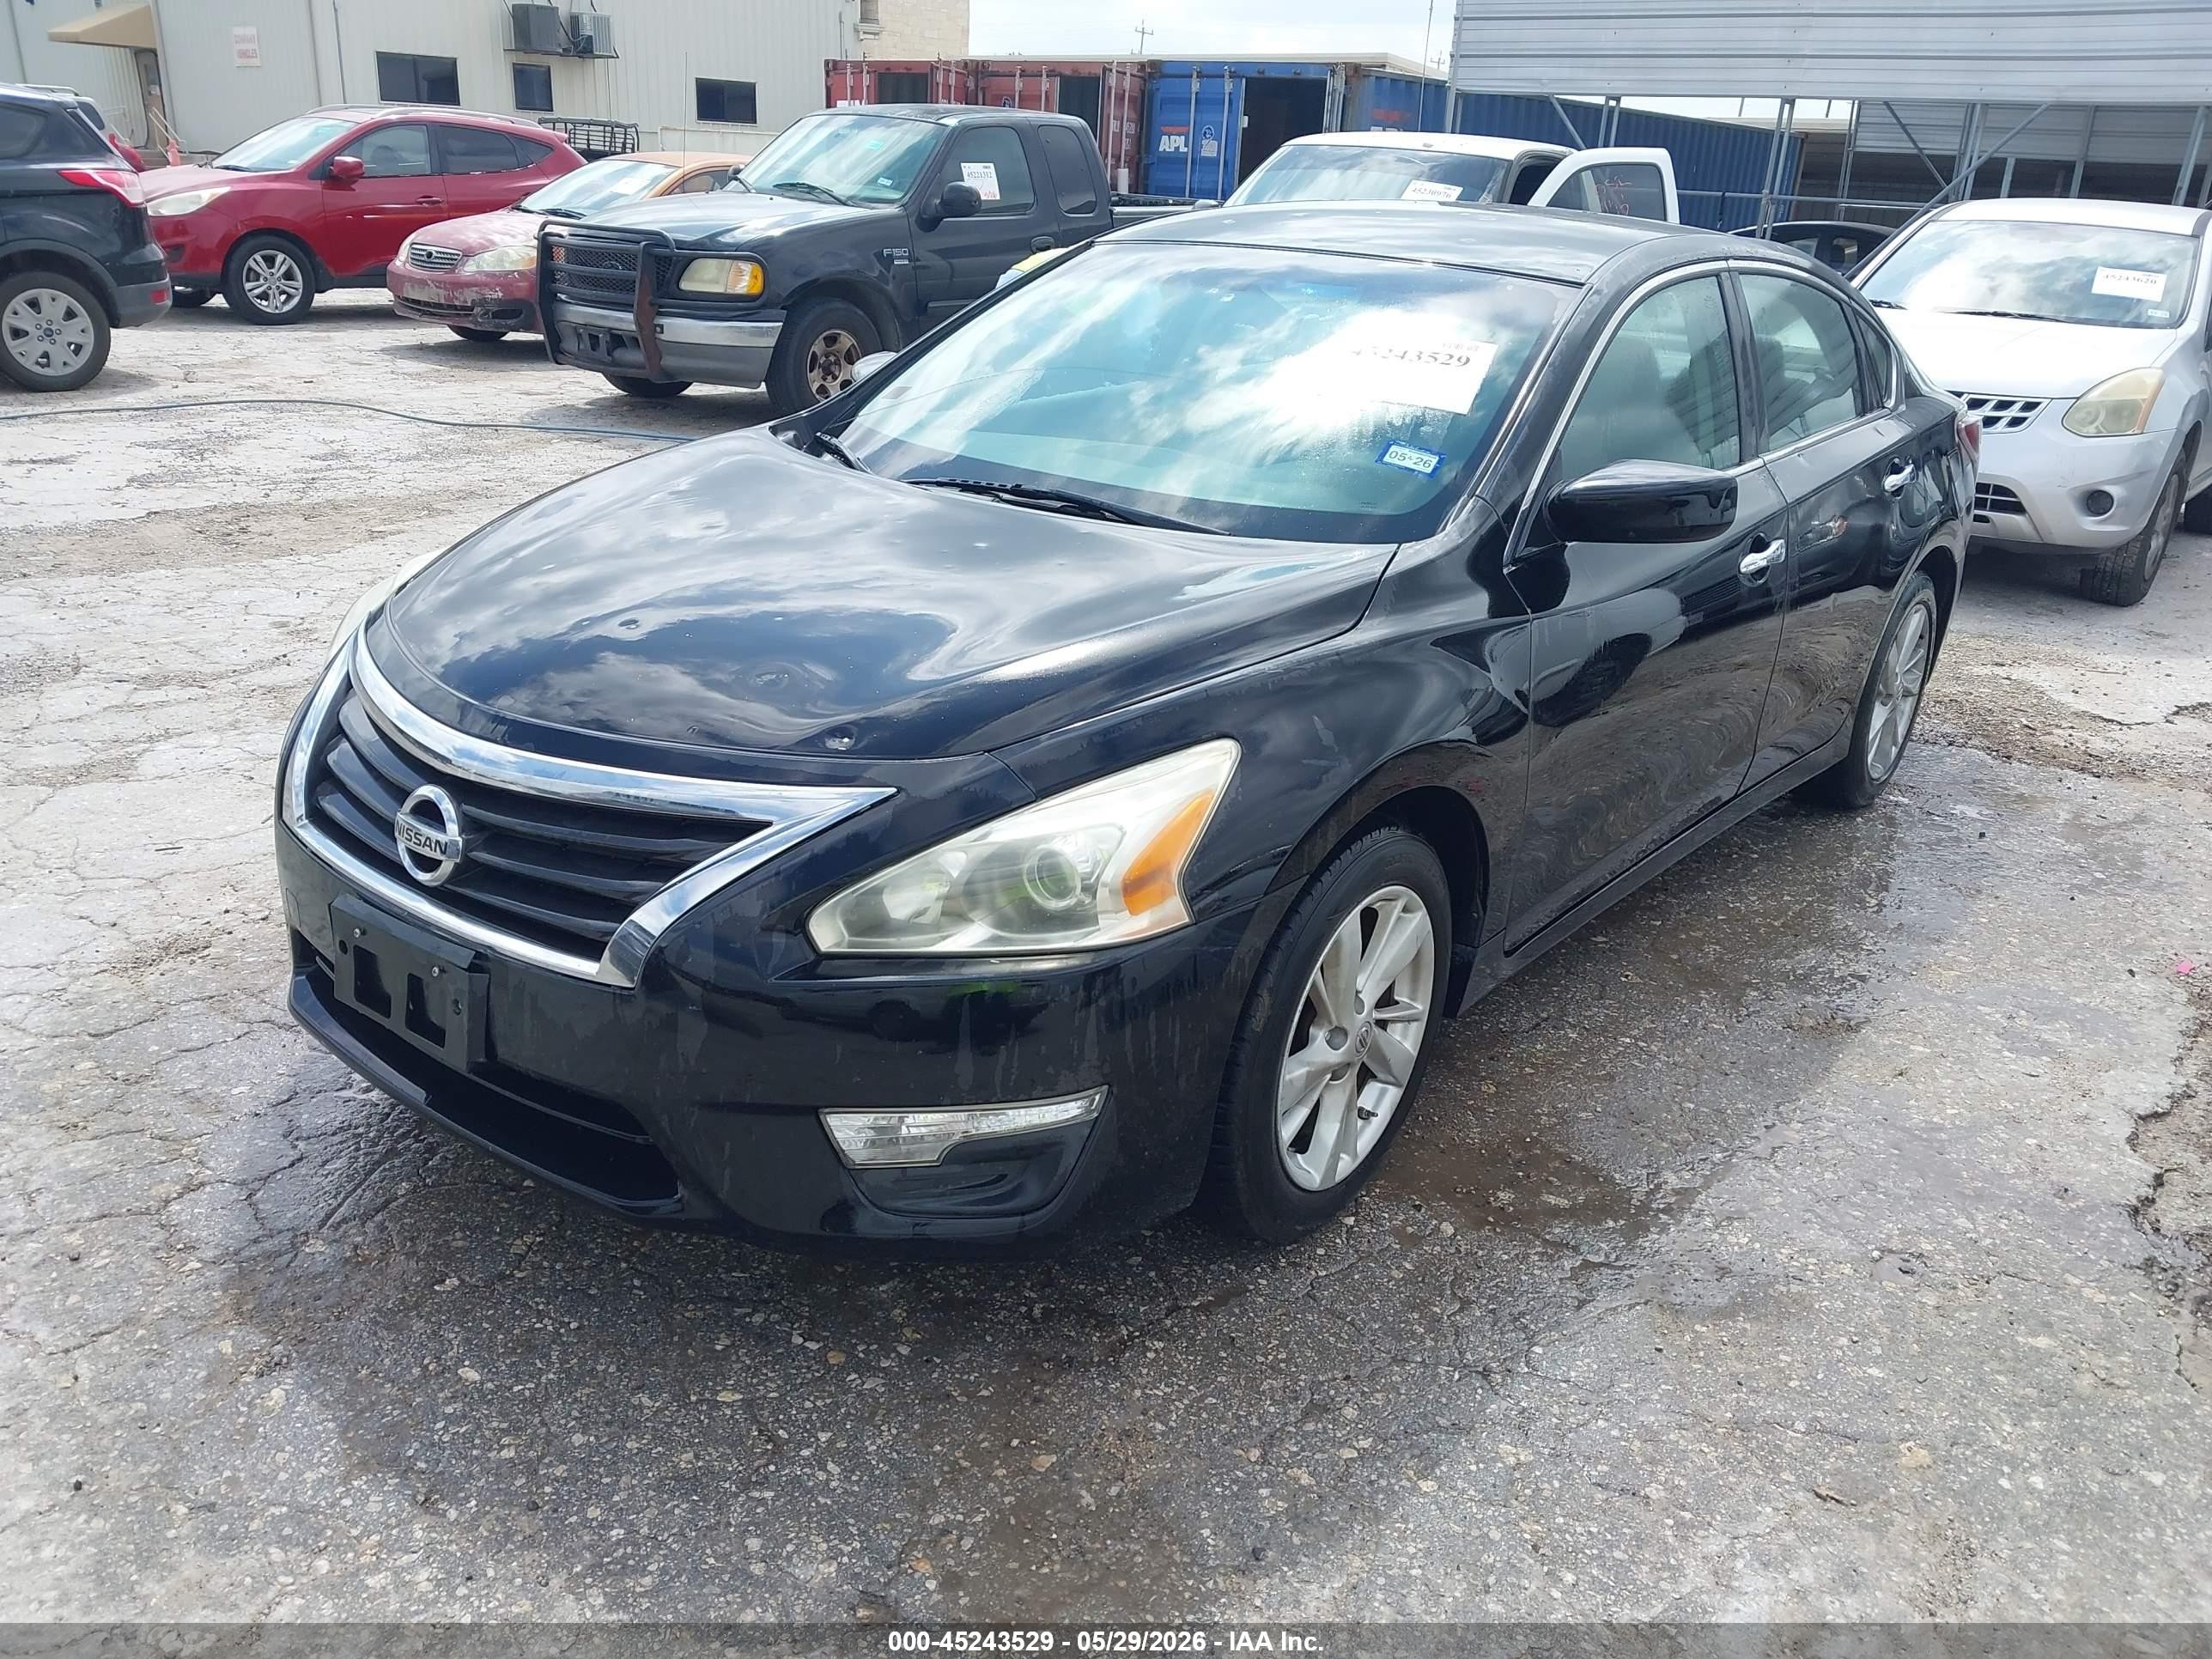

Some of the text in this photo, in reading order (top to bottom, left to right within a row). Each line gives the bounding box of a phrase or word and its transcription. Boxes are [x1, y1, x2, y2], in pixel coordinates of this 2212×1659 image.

[1158, 135, 1188, 152] APL
[883, 248, 908, 257] F150
[1388, 450, 1433, 469] 05 26
[395, 819, 447, 855] NISSAN
